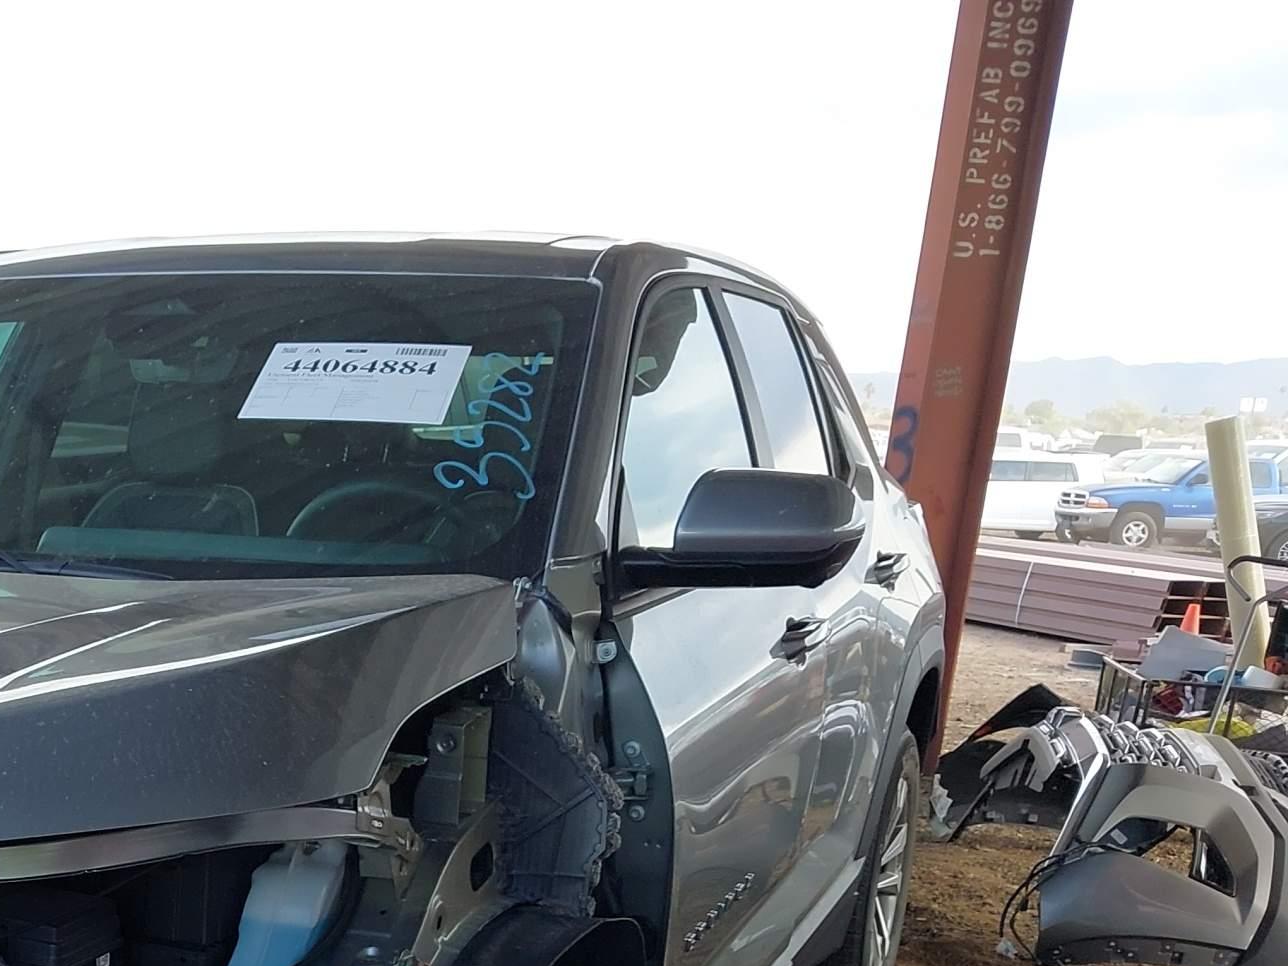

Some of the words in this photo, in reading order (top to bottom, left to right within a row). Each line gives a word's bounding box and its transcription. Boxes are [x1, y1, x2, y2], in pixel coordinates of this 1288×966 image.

[966, 67, 1003, 184] PREFAB
[953, 203, 982, 258] U.S.
[283, 358, 437, 375] 44064884
